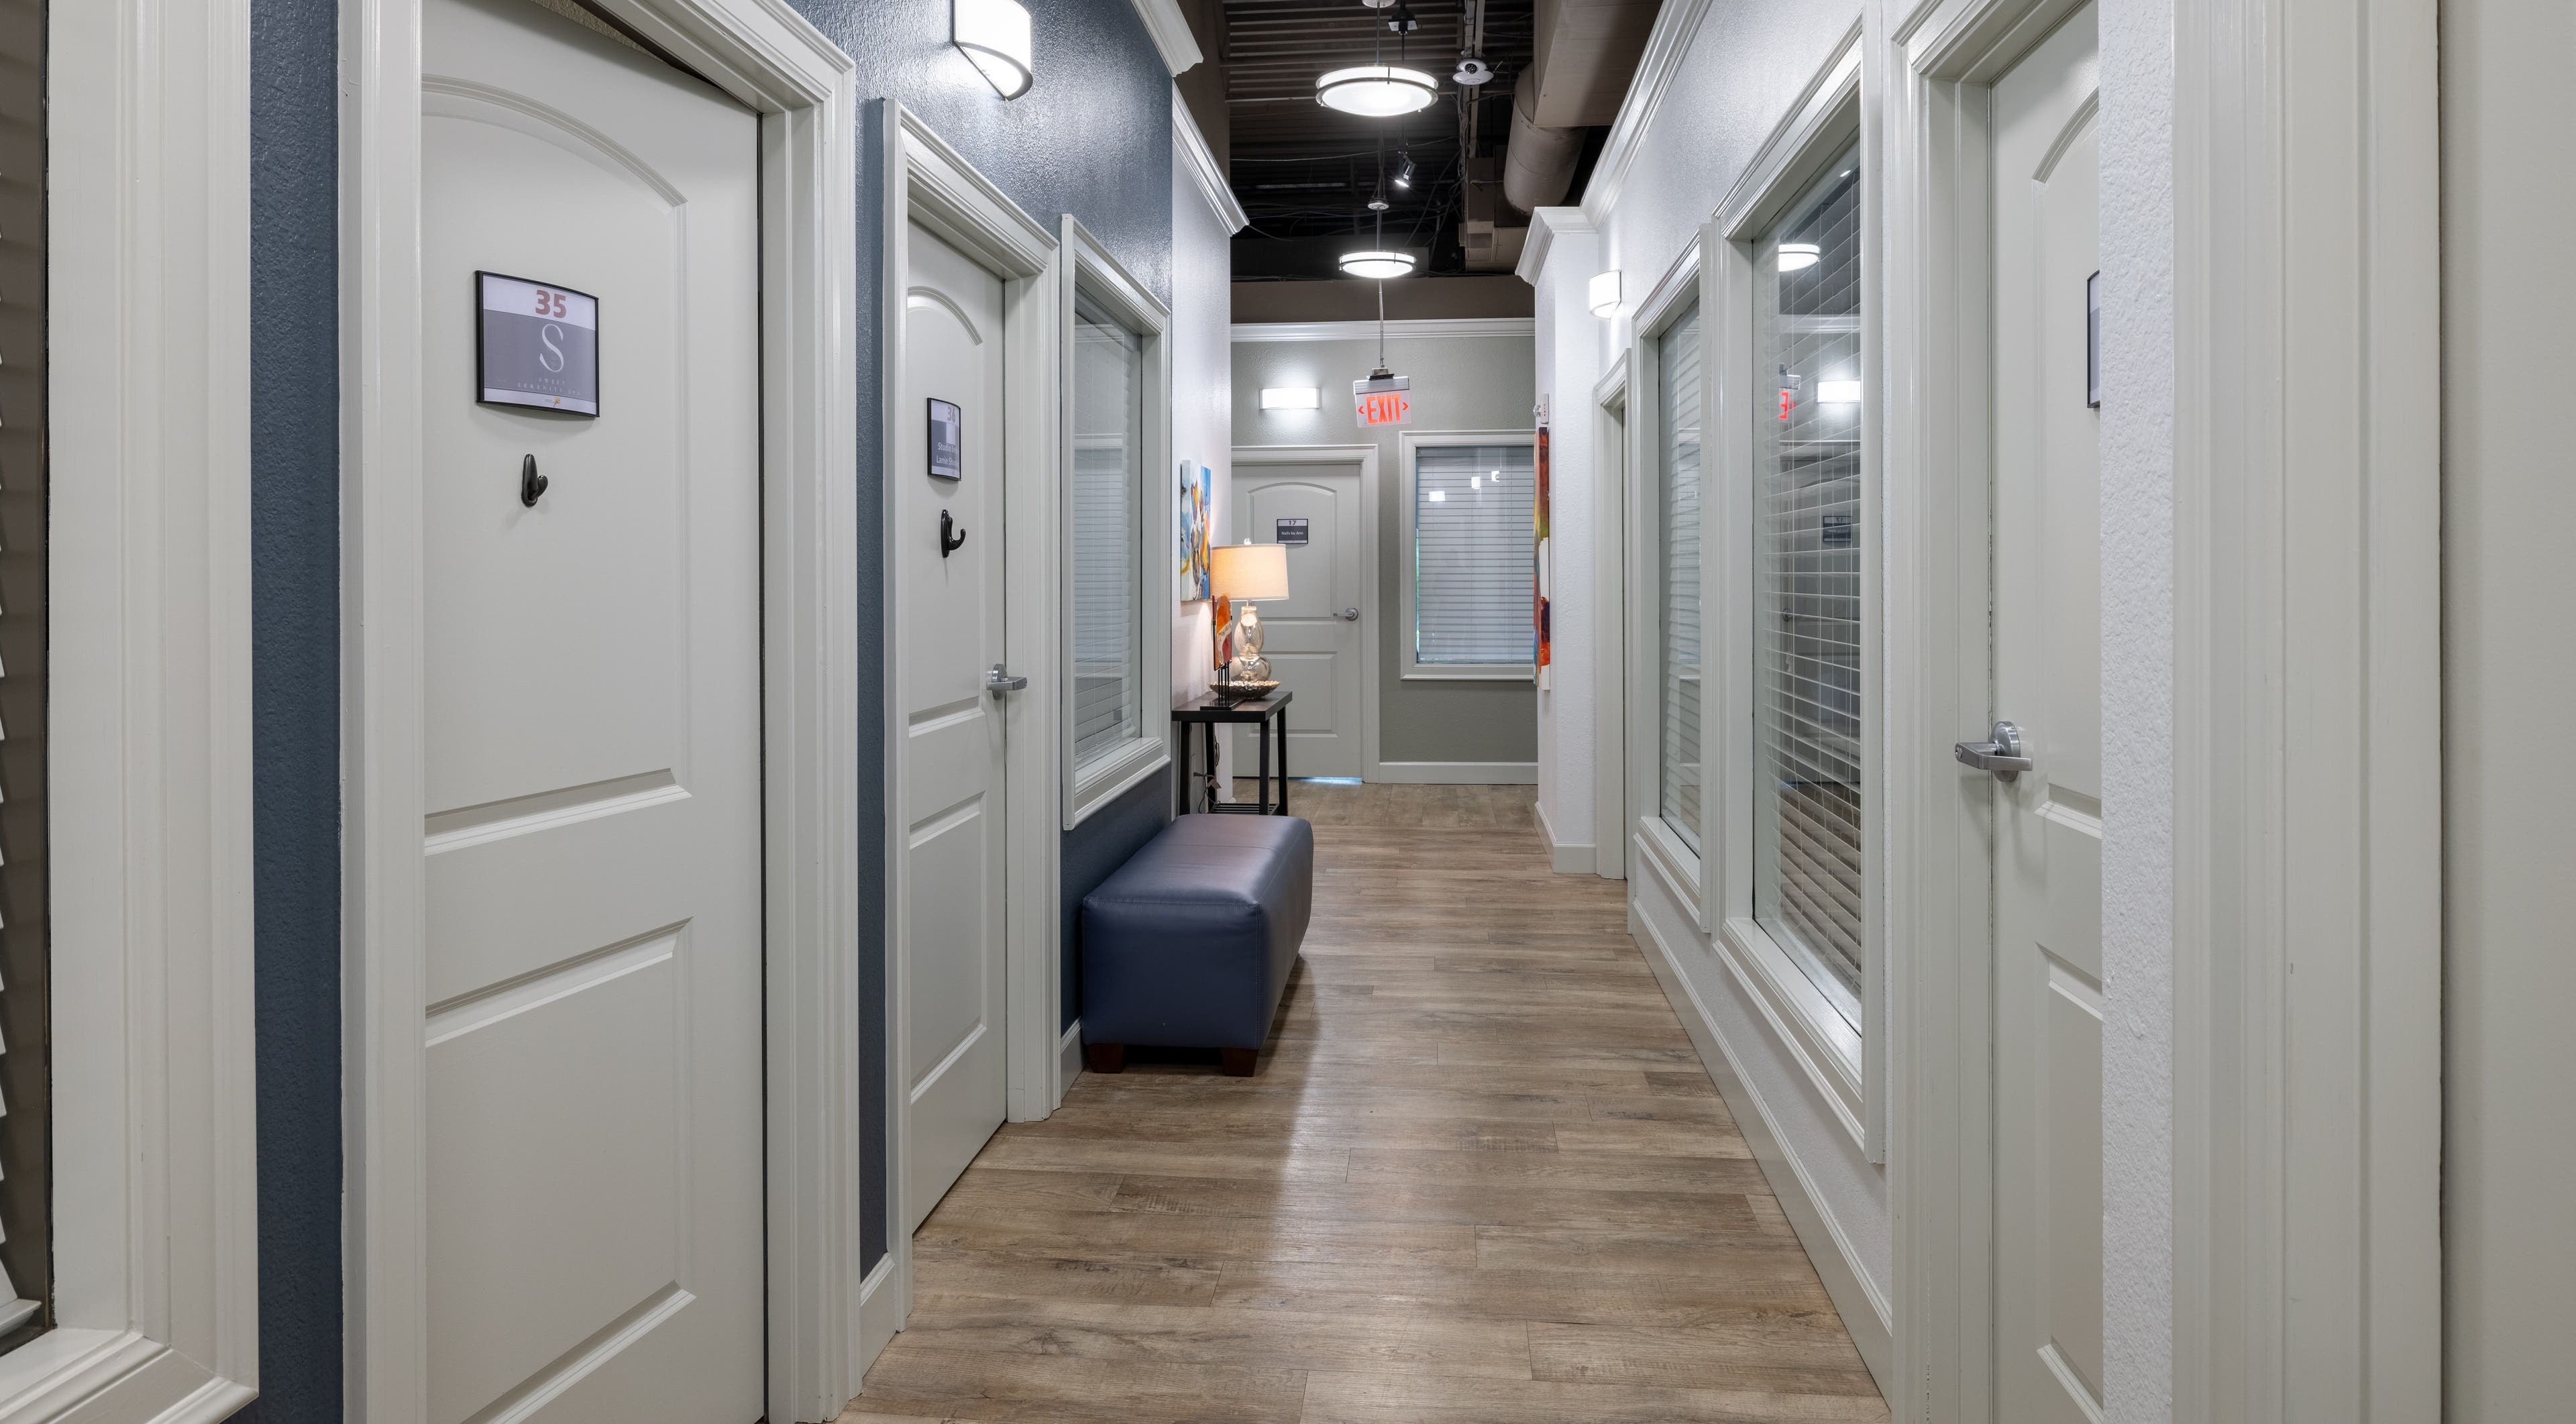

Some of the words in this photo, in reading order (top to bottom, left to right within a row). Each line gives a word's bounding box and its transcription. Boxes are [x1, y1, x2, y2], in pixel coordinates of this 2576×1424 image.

[535, 290, 567, 319] 35
[539, 323, 564, 372] S
[517, 382, 563, 392] SERENITY
[947, 406, 956, 423] 36
[1366, 394, 1401, 424] EXIT
[936, 455, 949, 465] Lanie
